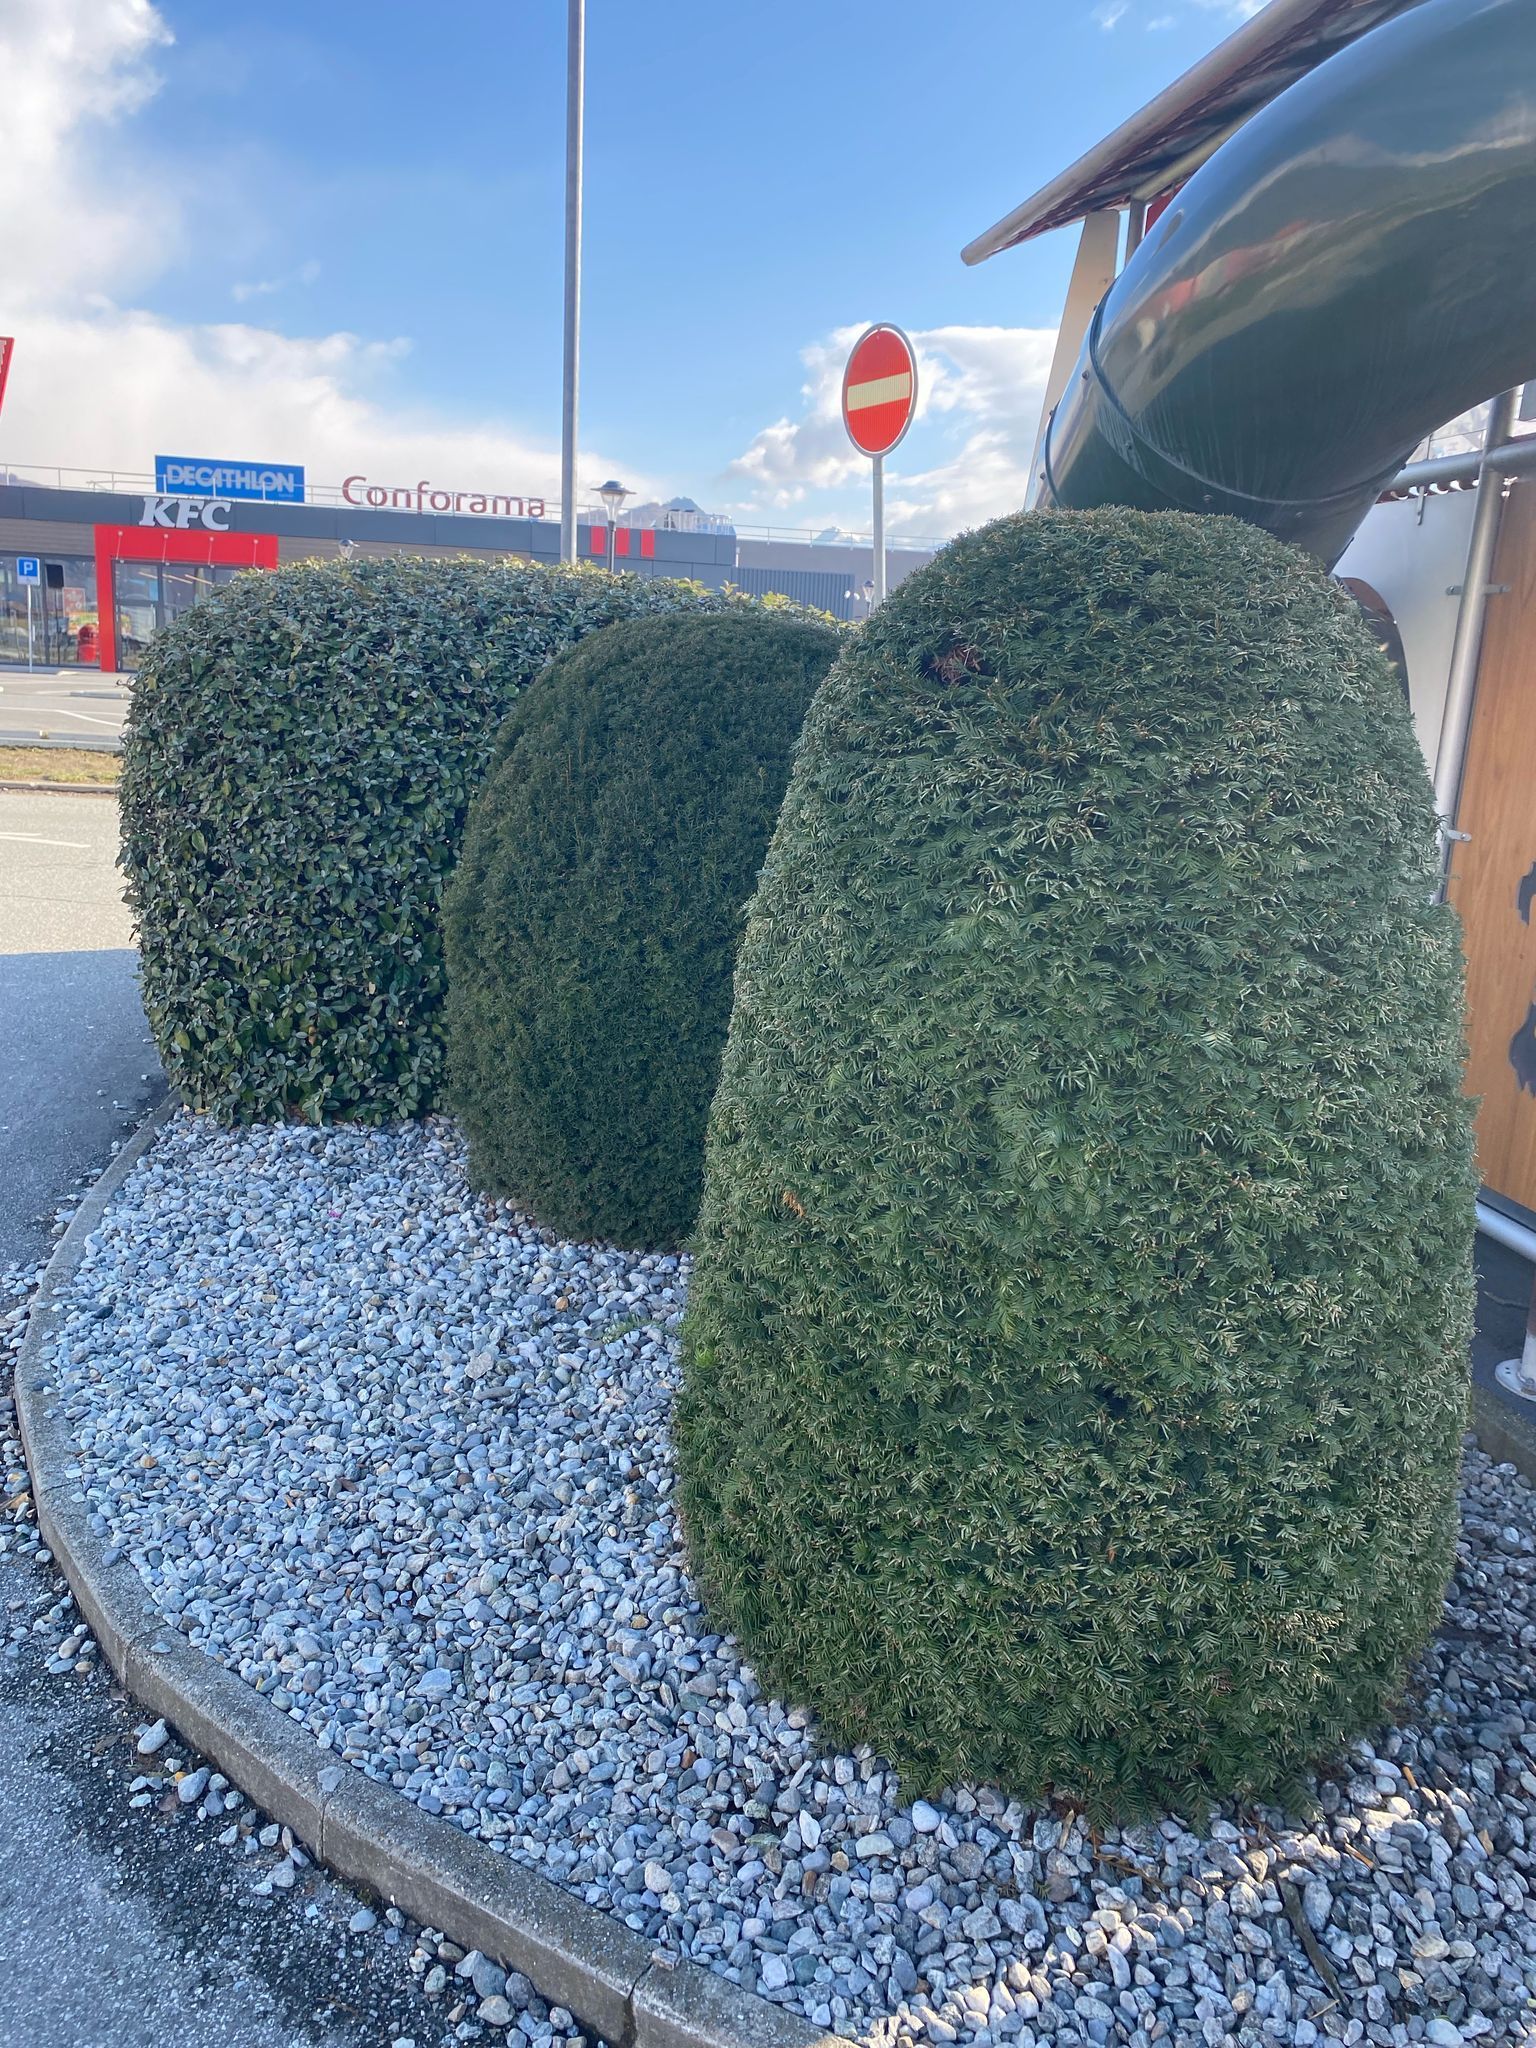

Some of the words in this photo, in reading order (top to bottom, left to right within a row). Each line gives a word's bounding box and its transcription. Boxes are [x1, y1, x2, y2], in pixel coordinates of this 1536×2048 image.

[166, 464, 294, 493] DECATHLON
[342, 475, 545, 518] Conforama
[139, 496, 232, 531] KFC
[24, 561, 33, 575] P
